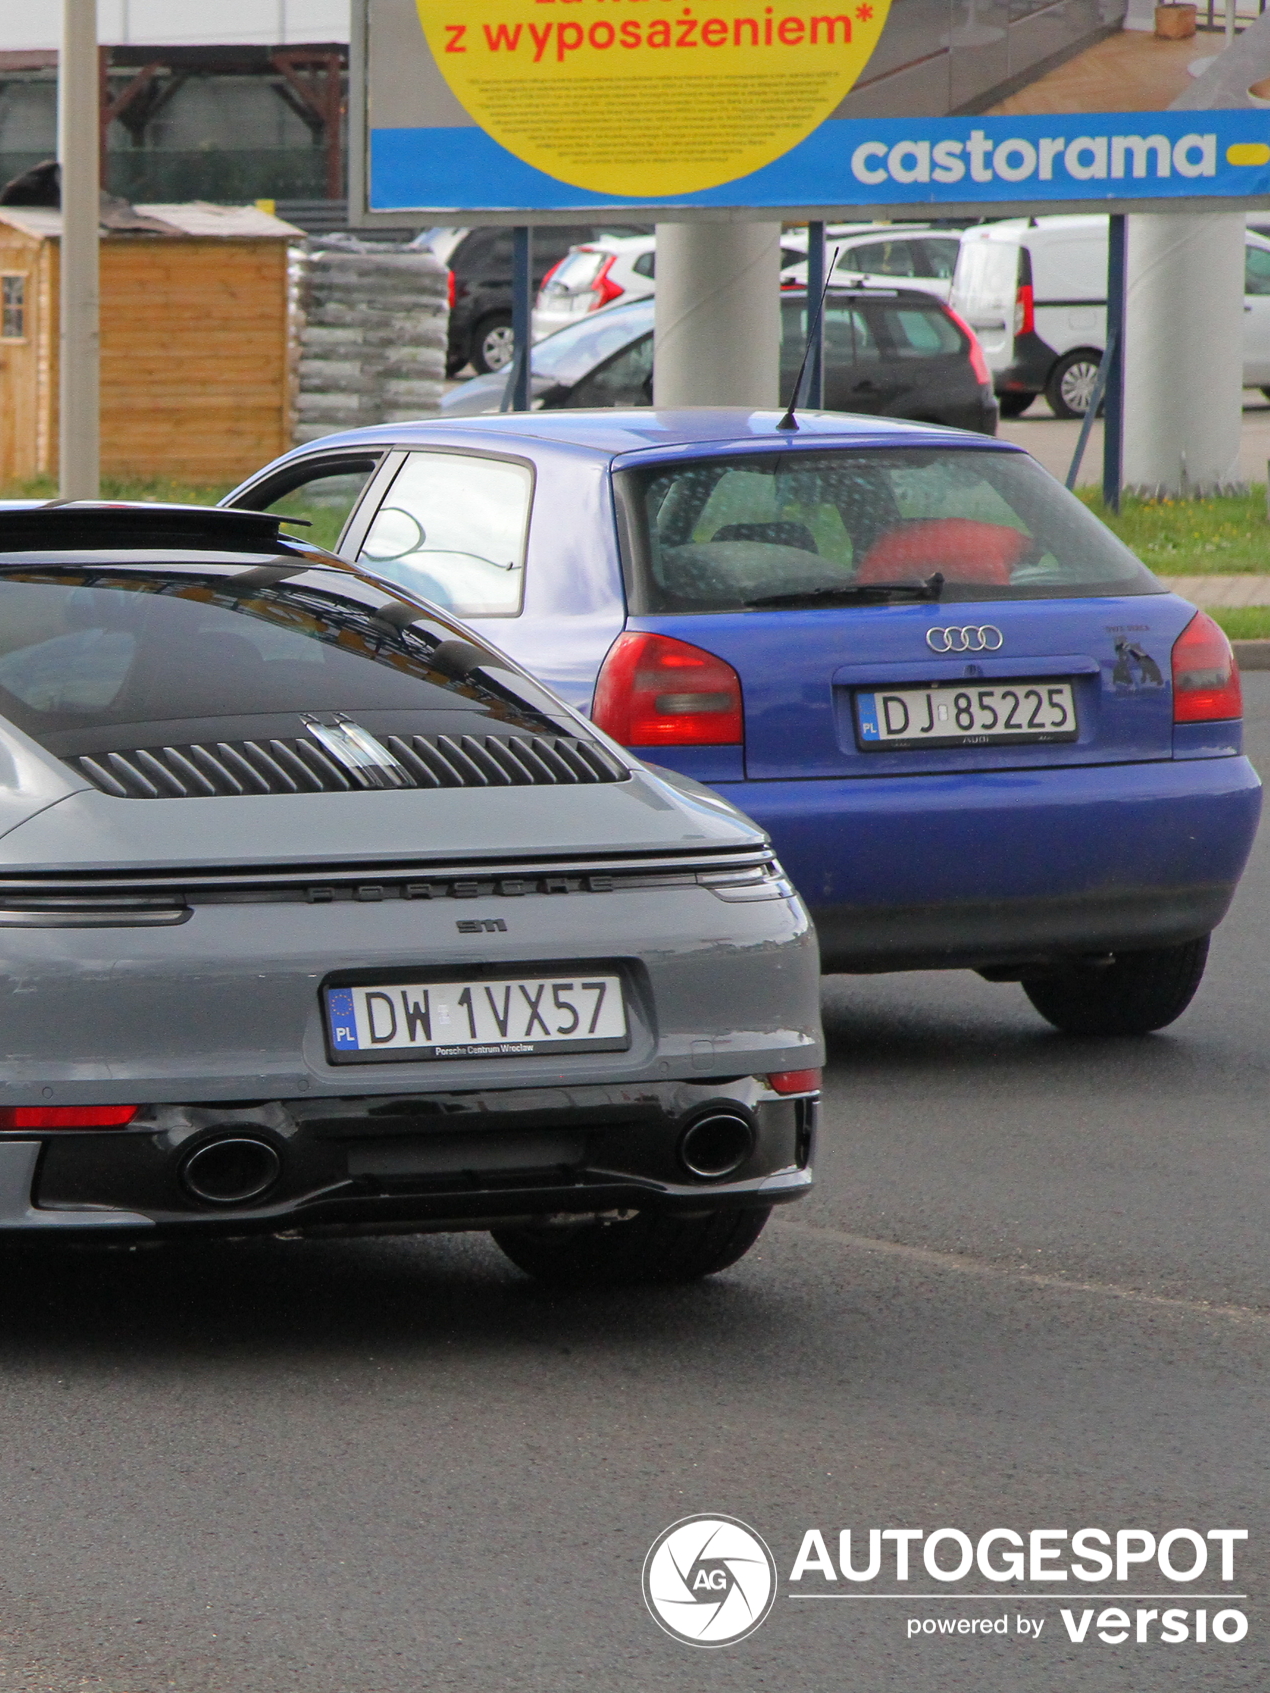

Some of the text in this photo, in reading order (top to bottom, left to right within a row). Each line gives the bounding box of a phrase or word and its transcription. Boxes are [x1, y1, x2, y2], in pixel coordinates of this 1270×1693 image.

[444, 23, 467, 53] z
[851, 130, 1218, 185] castorama
[883, 689, 1068, 735] DJ 85225
[862, 723, 877, 734] PL
[307, 876, 614, 903] PORSCHE
[456, 918, 508, 934] 911
[365, 982, 607, 1044] DW 1VX57
[336, 1027, 355, 1042] PL
[435, 1046, 467, 1056] Porsche
[468, 1044, 500, 1054] Centrum
